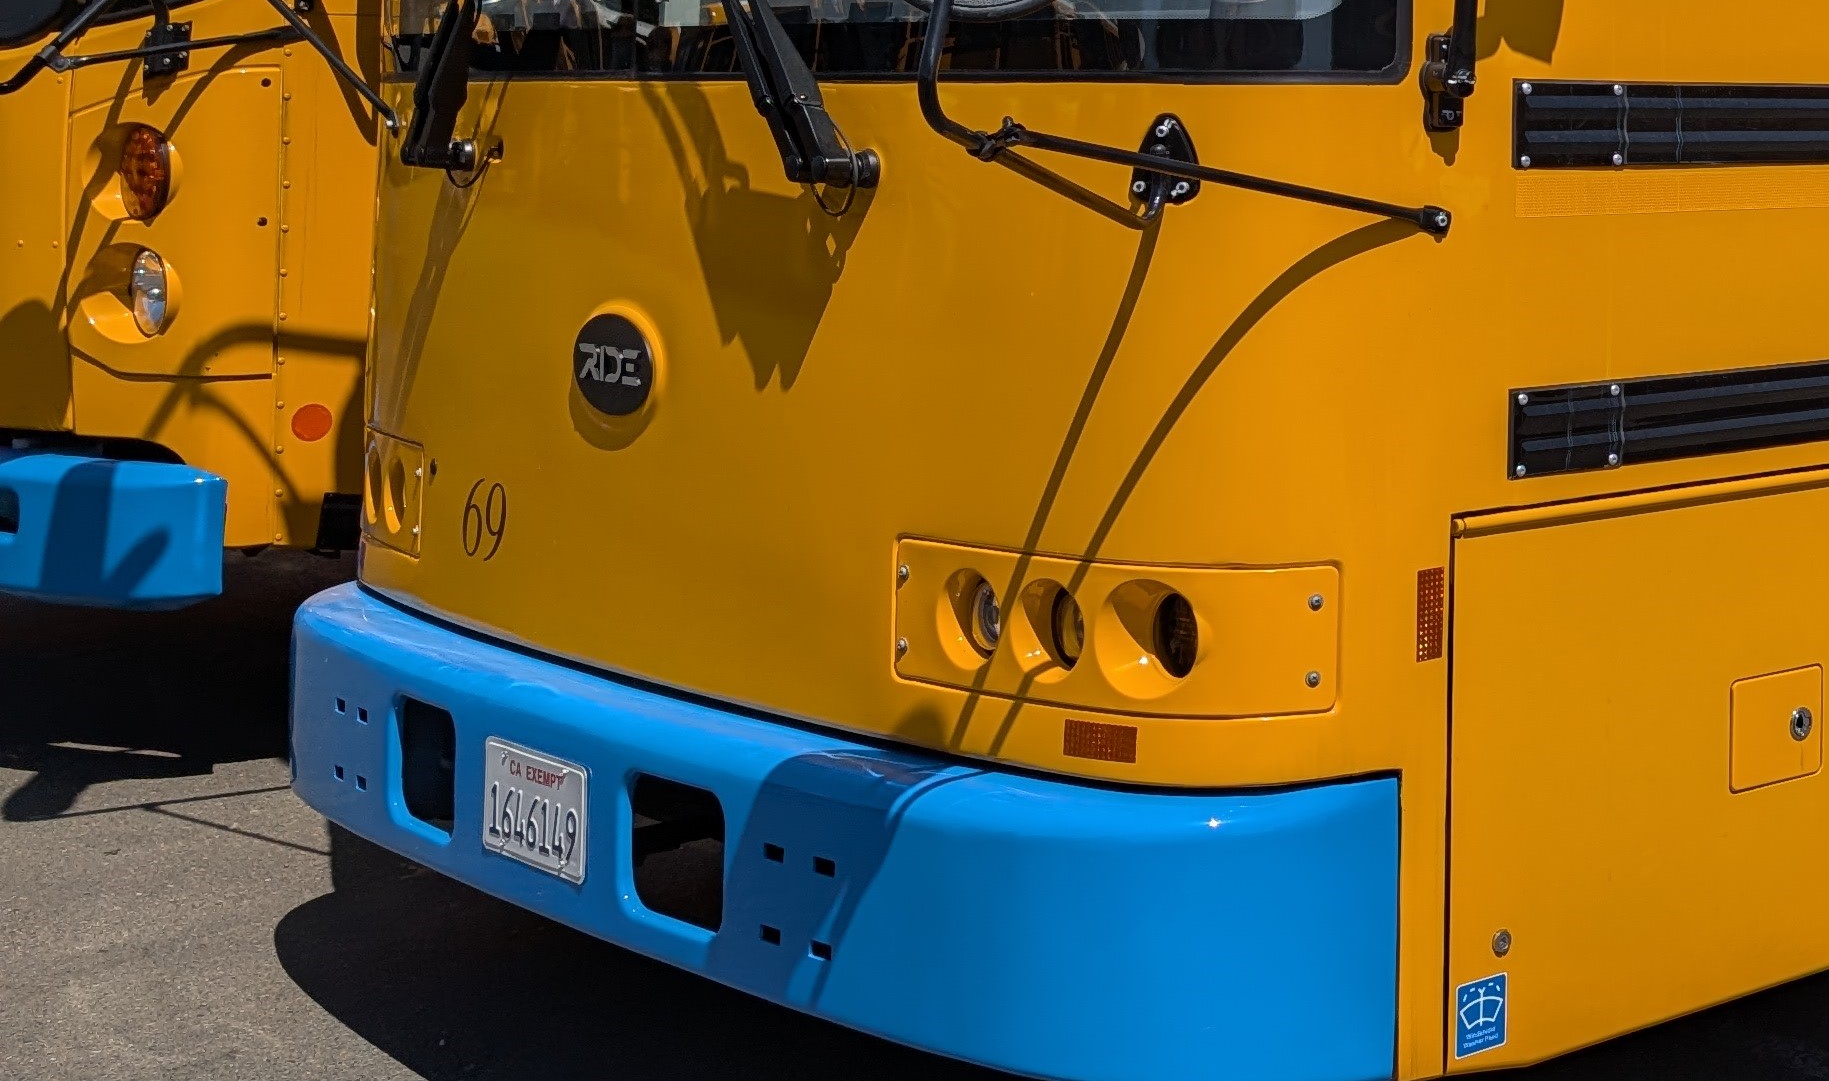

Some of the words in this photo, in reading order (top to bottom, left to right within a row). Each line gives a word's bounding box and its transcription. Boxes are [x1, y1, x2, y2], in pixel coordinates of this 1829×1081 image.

[579, 343, 641, 387] RIDE
[462, 478, 507, 562] 69
[509, 760, 522, 777] CA
[526, 766, 565, 790] EXEMPT
[489, 782, 579, 864] 1646149
